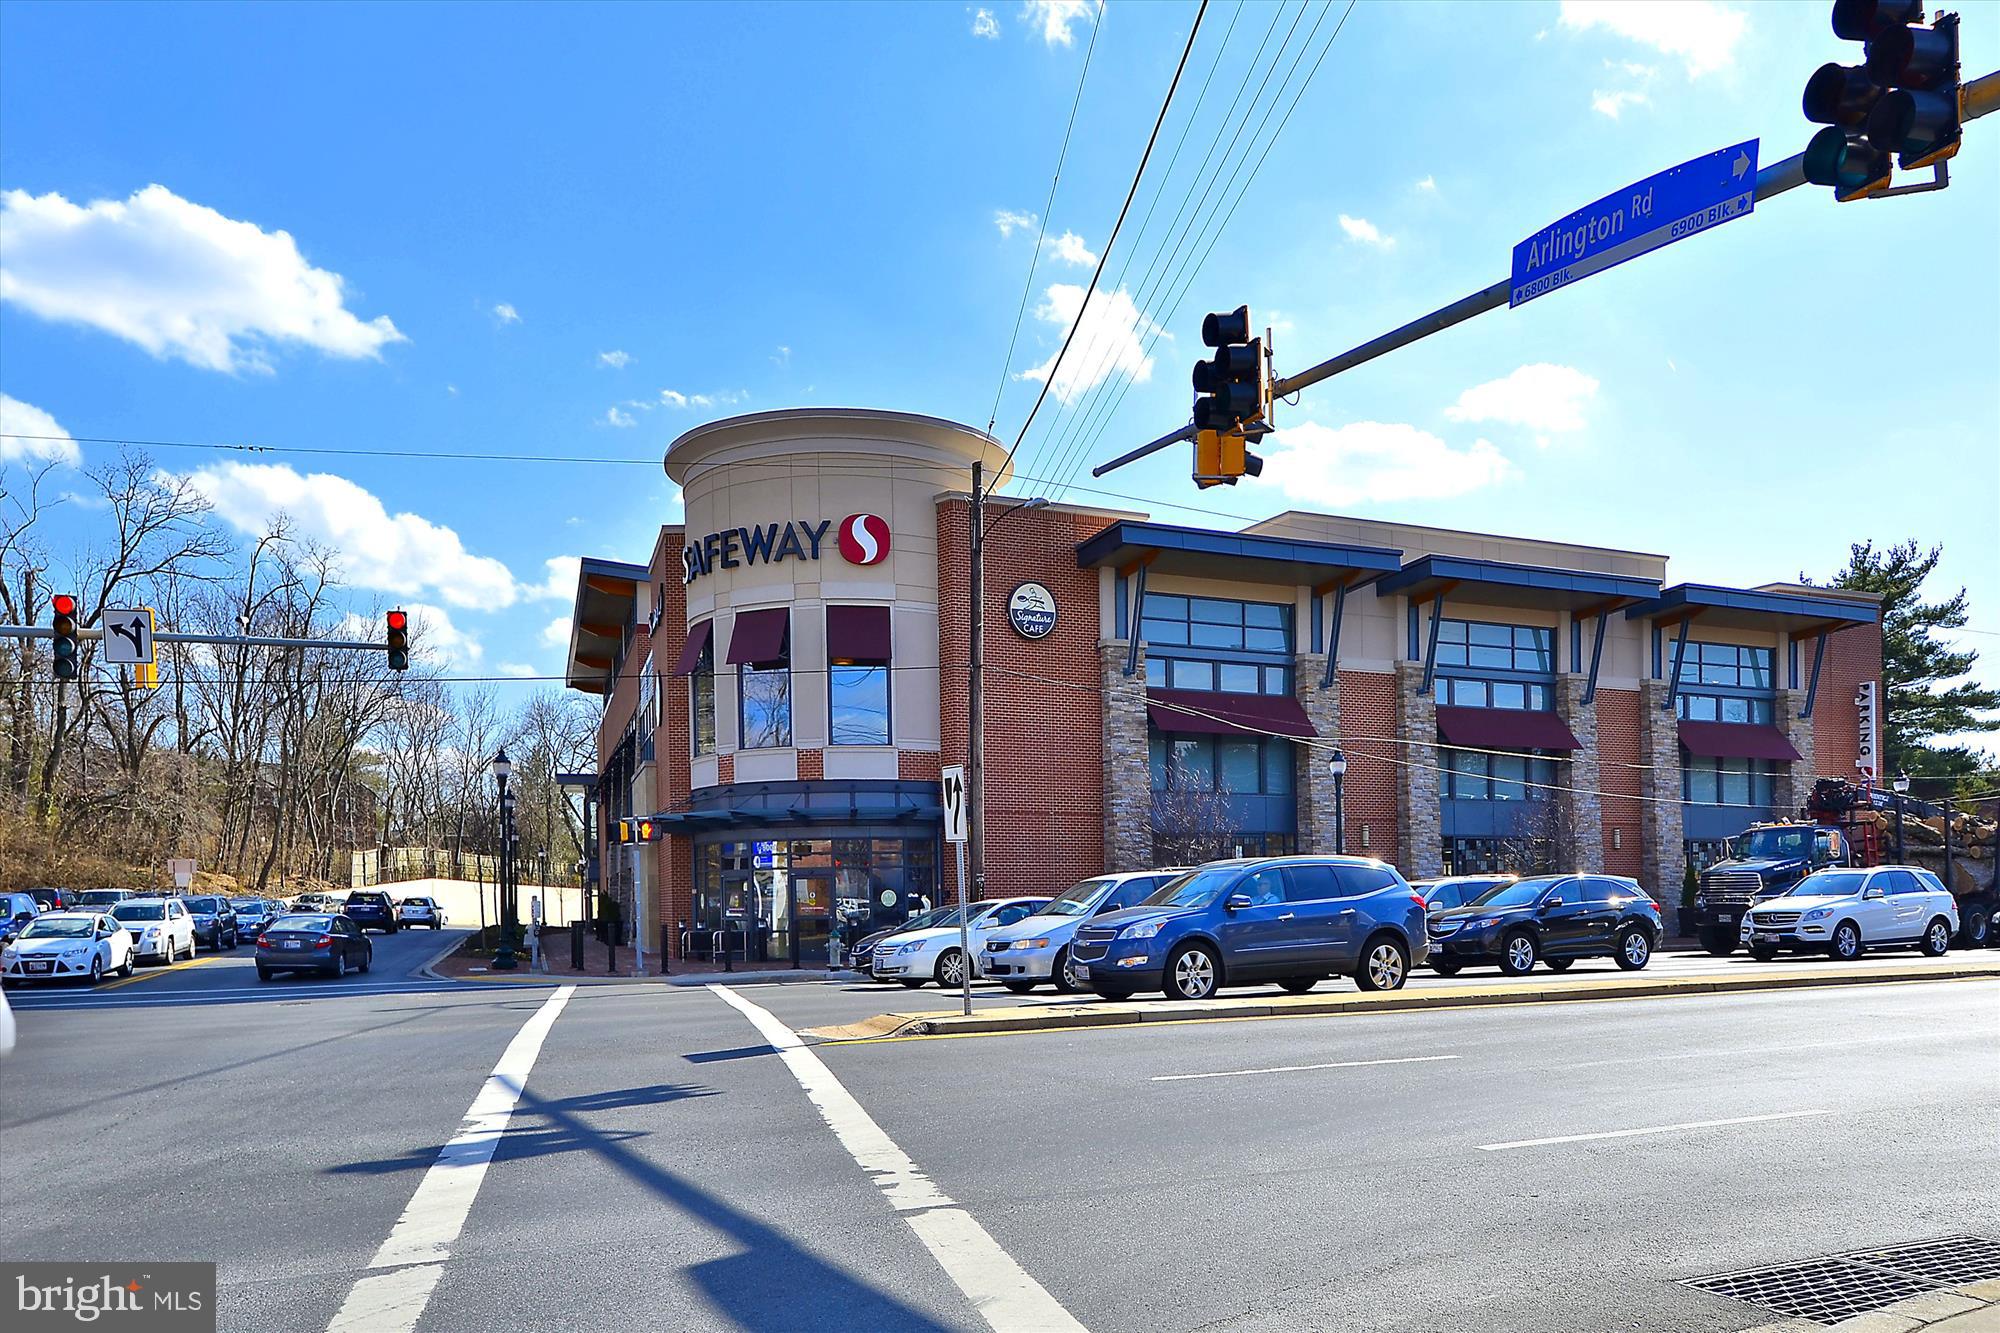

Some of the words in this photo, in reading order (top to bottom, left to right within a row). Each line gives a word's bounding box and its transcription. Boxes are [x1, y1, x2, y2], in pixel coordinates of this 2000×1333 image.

[1526, 208, 1624, 273] Arlington
[1631, 186, 1653, 219] Rd
[1671, 213, 1704, 237] 6900
[1708, 203, 1734, 223] Blk.
[1524, 277, 1550, 297] 6800
[1553, 268, 1574, 286] Blk.
[682, 519, 832, 584] SAFEWAY
[1015, 610, 1053, 625] Signature
[1023, 624, 1044, 634] CAFE
[1859, 683, 1871, 756] PARKING
